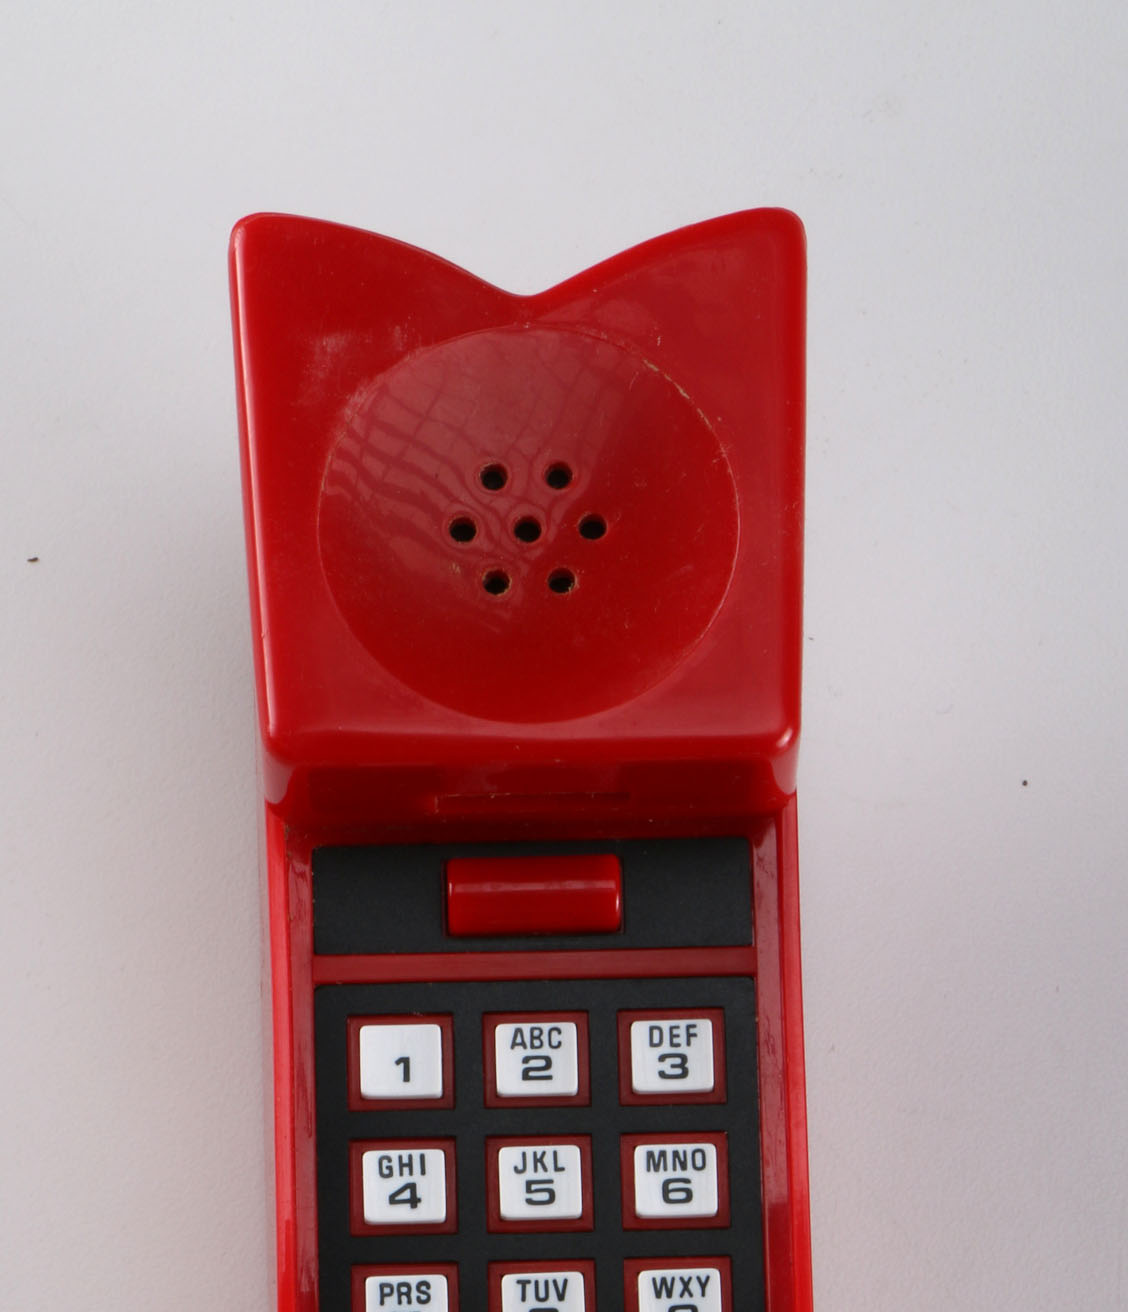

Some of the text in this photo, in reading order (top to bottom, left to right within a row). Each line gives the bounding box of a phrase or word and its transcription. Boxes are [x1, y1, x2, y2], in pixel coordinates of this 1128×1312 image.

[511, 1027, 562, 1050] ABC
[649, 1024, 697, 1048] DEF
[395, 1057, 410, 1082] 1
[522, 1055, 553, 1081] 2
[658, 1053, 689, 1079] 3
[378, 1153, 426, 1178] GHI
[514, 1150, 565, 1174] JKL
[646, 1148, 706, 1172] MNO
[389, 1182, 421, 1209] 4
[525, 1179, 555, 1205] 5
[662, 1178, 693, 1204] 6
[379, 1280, 431, 1306] PRS
[516, 1278, 568, 1302] TUV
[652, 1275, 710, 1299] WXY
